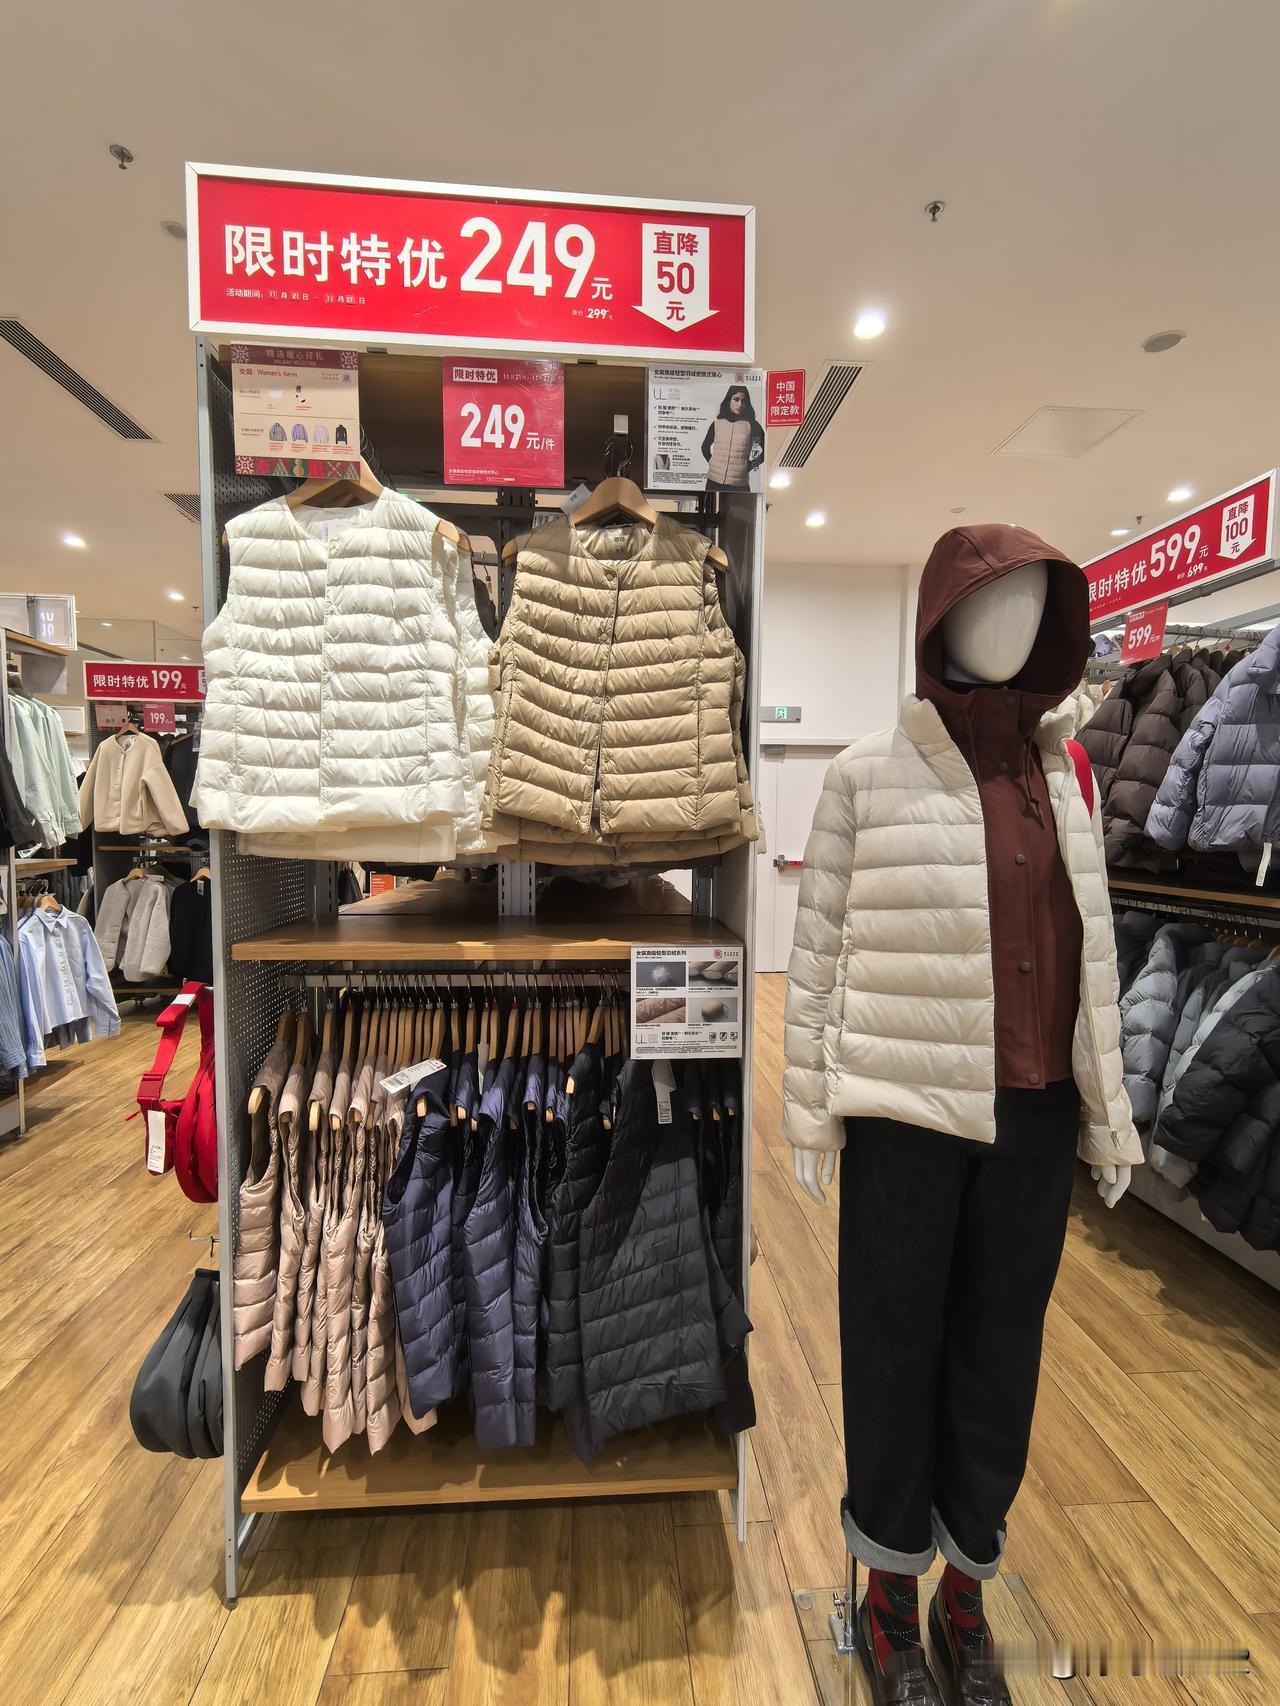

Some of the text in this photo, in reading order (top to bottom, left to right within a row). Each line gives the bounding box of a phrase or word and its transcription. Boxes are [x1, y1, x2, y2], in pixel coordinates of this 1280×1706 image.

[652, 230, 699, 257] 直降
[224, 224, 447, 289] 限时特优
[657, 261, 695, 295] 50
[666, 301, 686, 321] 元
[454, 368, 496, 382] 限时特优
[776, 381, 796, 391] 中国
[776, 393, 795, 404] 大陆
[770, 405, 800, 416] 限定款
[1226, 500, 1249, 522] 直降
[1225, 518, 1249, 543] 100
[1230, 541, 1240, 555] 元
[93, 674, 149, 688] 限时特优
